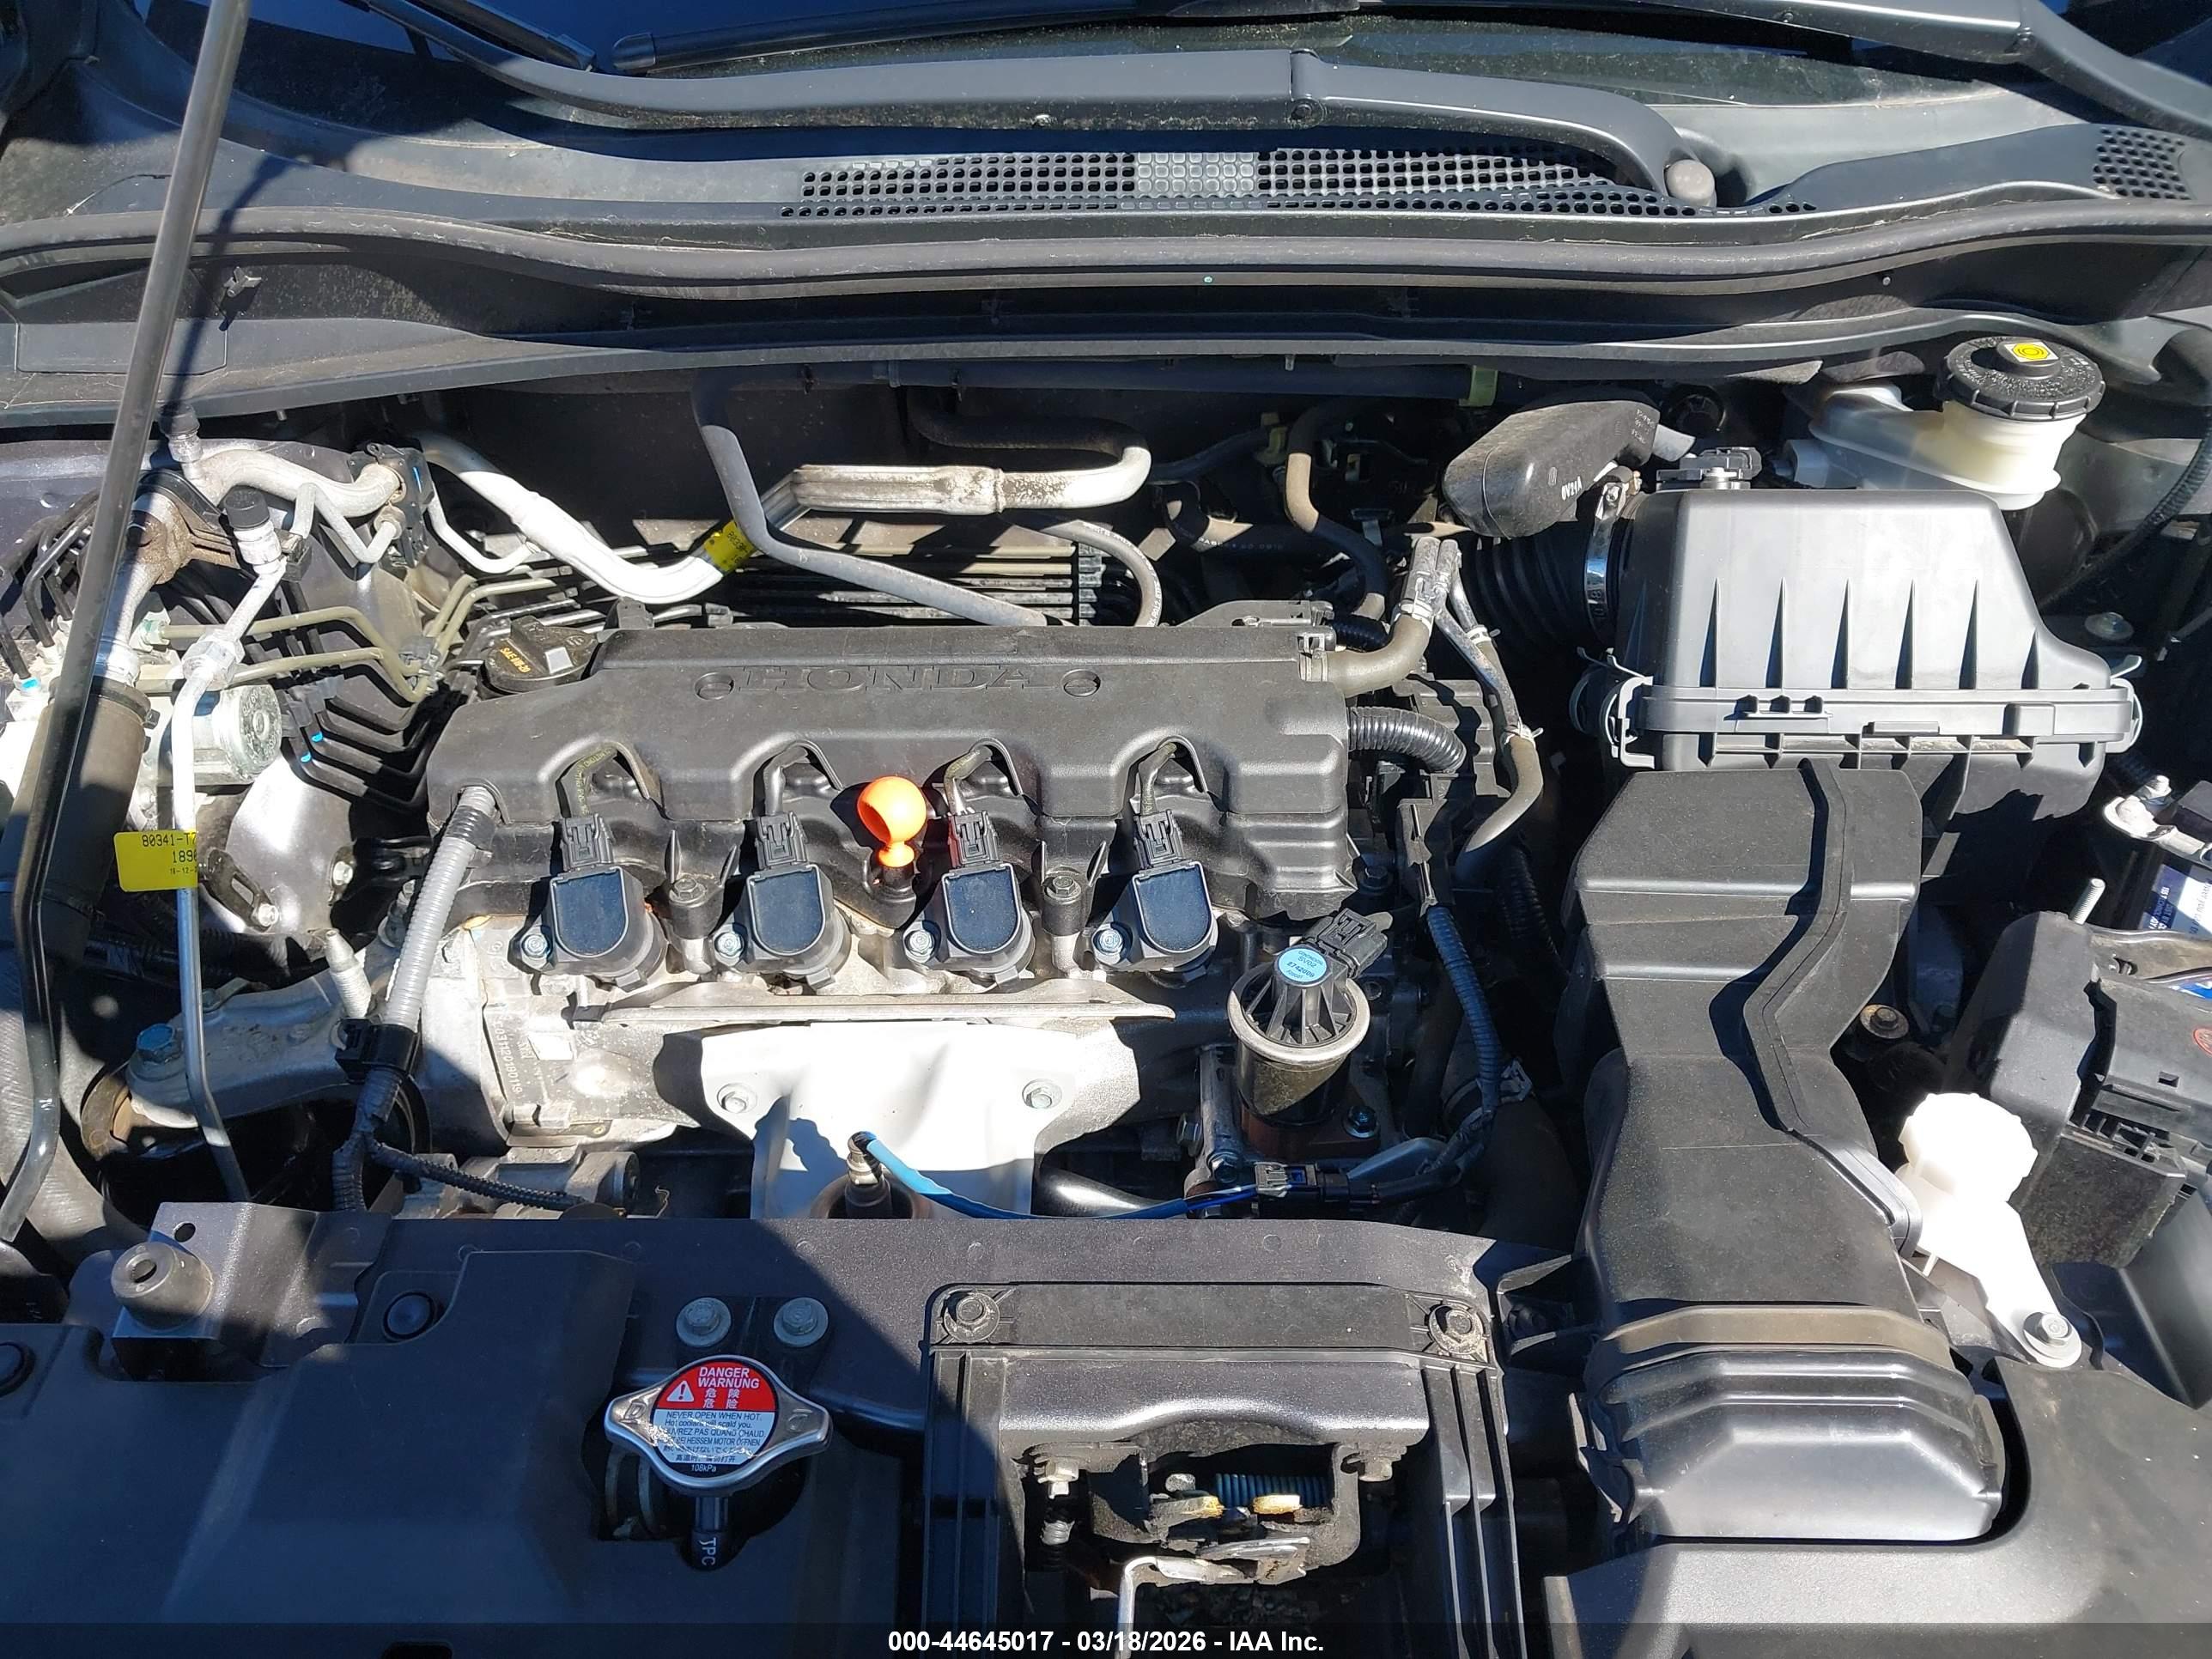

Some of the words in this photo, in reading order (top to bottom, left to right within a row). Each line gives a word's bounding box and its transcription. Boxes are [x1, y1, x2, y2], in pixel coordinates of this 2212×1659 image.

[500, 647, 517, 660] SAE
[739, 665, 1030, 691] HONDA
[699, 1366, 750, 1378] DANGER
[697, 1377, 760, 1389] WARNUNG
[666, 1411, 692, 1419] NEVER
[744, 1413, 763, 1421] HOT.
[710, 1429, 737, 1437] QUAND
[738, 1429, 765, 1437] CHAUD.
[690, 1464, 717, 1473] 108kPa
